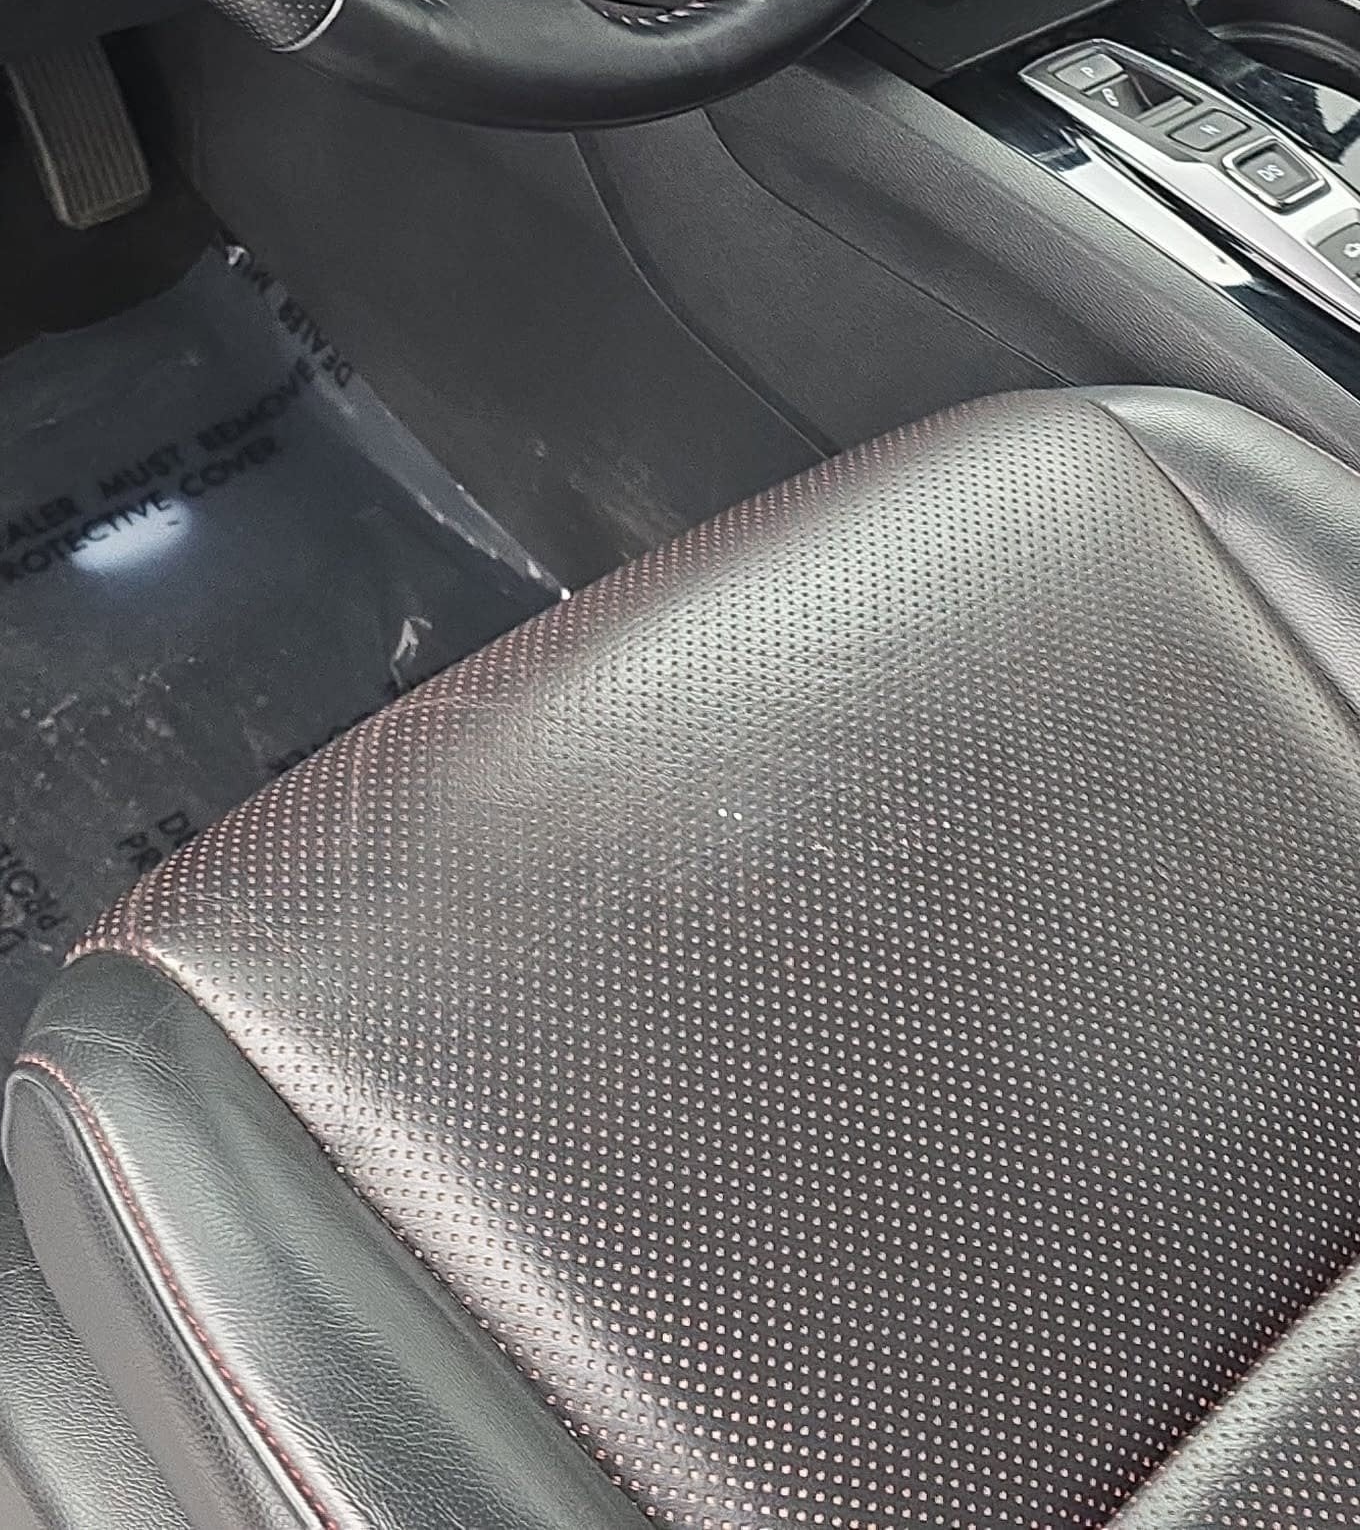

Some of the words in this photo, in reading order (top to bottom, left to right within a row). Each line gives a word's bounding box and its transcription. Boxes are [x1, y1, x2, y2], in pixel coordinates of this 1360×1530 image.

[99, 443, 184, 501] MUST
[195, 356, 315, 453] REMOVE
[179, 434, 278, 497] COVER
